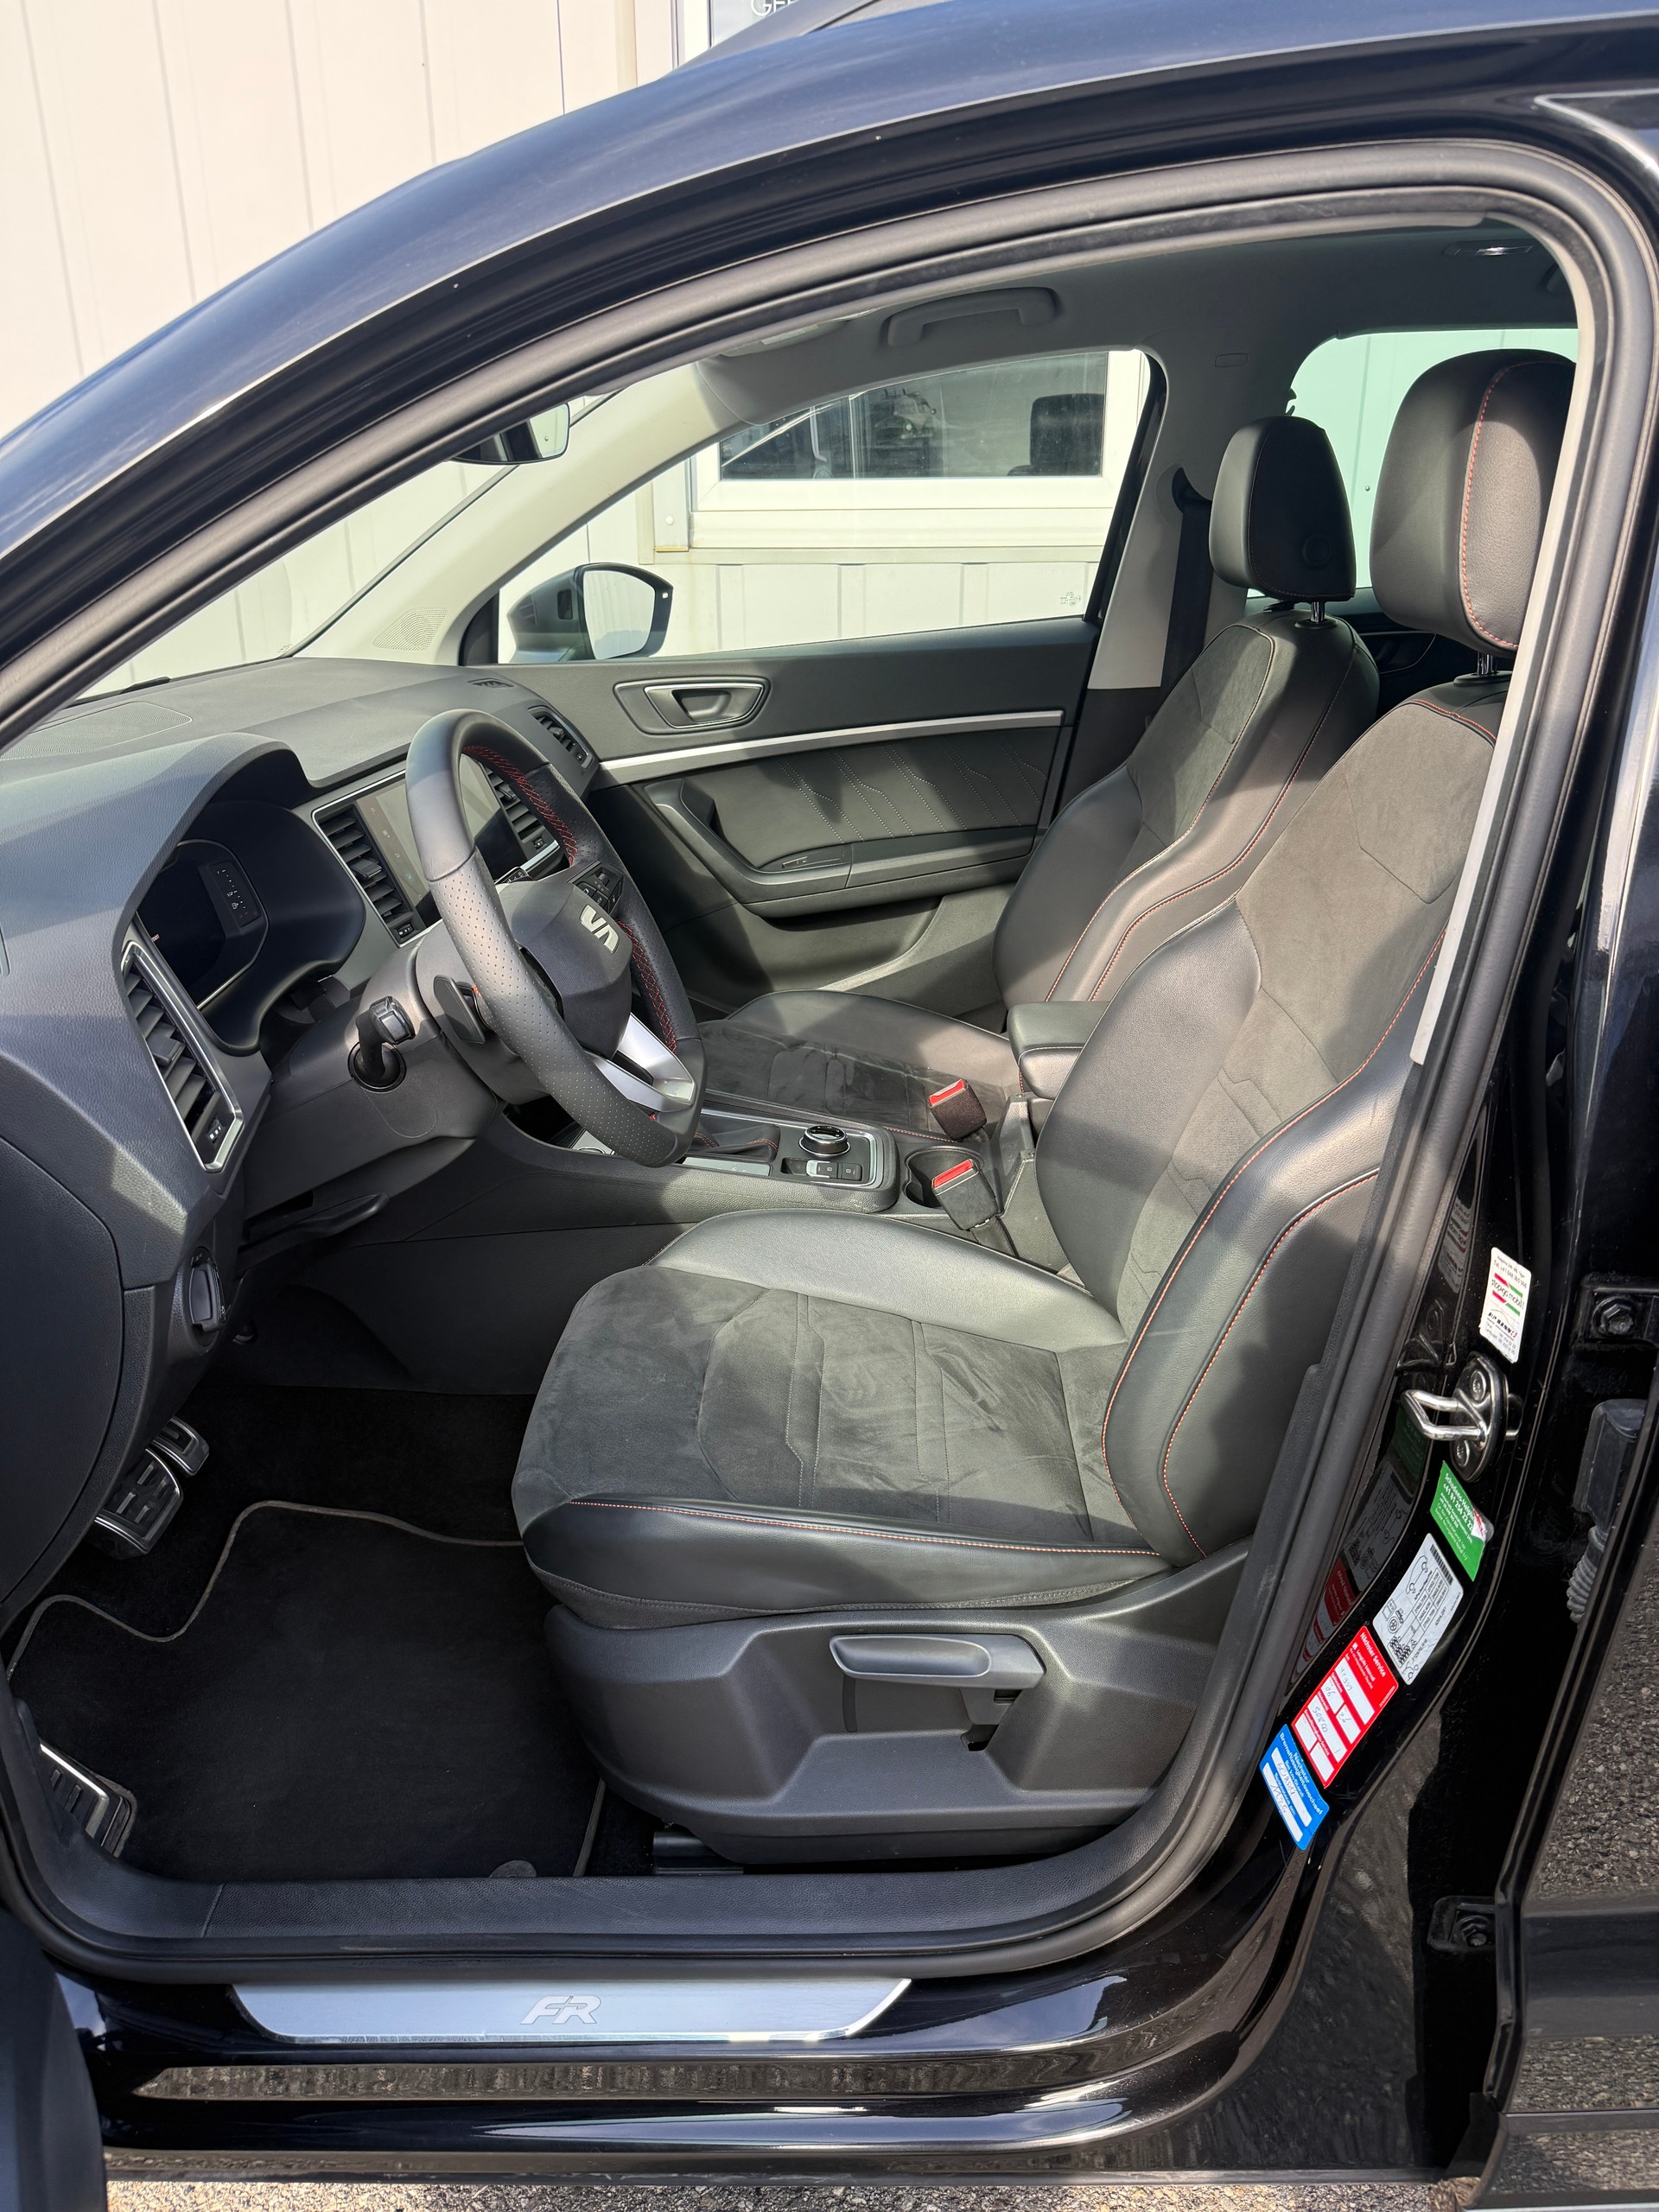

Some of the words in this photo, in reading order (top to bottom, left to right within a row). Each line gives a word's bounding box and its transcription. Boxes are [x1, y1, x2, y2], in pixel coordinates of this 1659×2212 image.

[1359, 1630, 1375, 1657] Nächster
[1372, 1655, 1386, 1677] Service
[519, 1995, 601, 2025] FR
